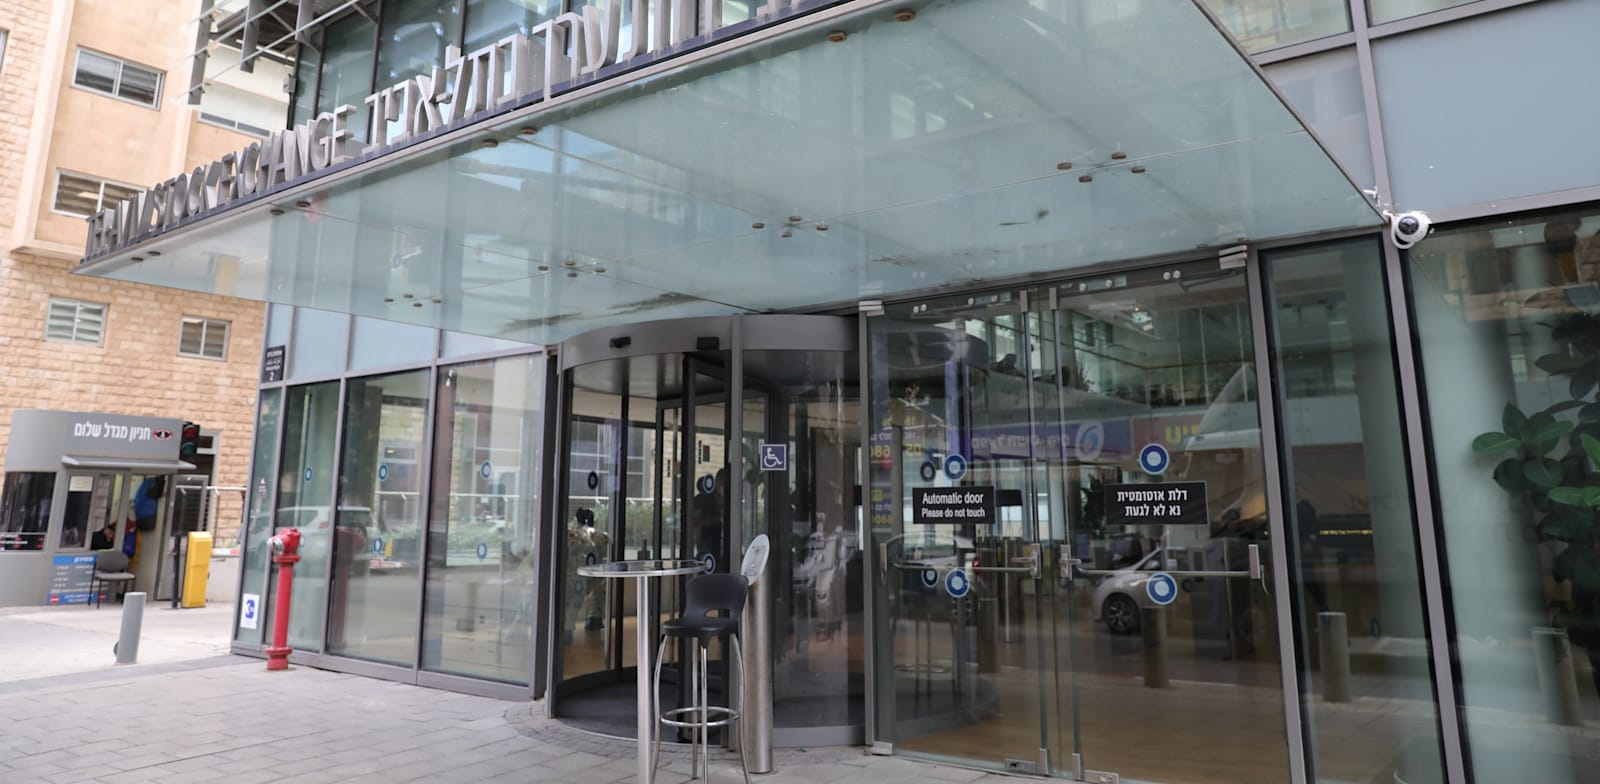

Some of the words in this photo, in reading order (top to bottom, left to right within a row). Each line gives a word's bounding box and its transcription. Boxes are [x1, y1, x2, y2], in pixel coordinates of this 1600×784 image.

[150, 161, 223, 232] STOCK
[217, 104, 358, 202] EXCHANGE
[73, 420, 102, 438] שלום
[103, 421, 129, 439] מגדל
[129, 426, 151, 443] חניון
[922, 491, 963, 505] Automatic
[964, 491, 984, 504] door
[1116, 490, 1165, 502] אוטומטית
[1168, 487, 1188, 501] דלת
[921, 507, 944, 518] Please
[944, 507, 954, 518] do
[954, 507, 966, 518] not
[966, 507, 986, 518] touch
[1124, 503, 1150, 516] לגעת
[1153, 503, 1165, 516] לא
[1169, 504, 1181, 516] נא
